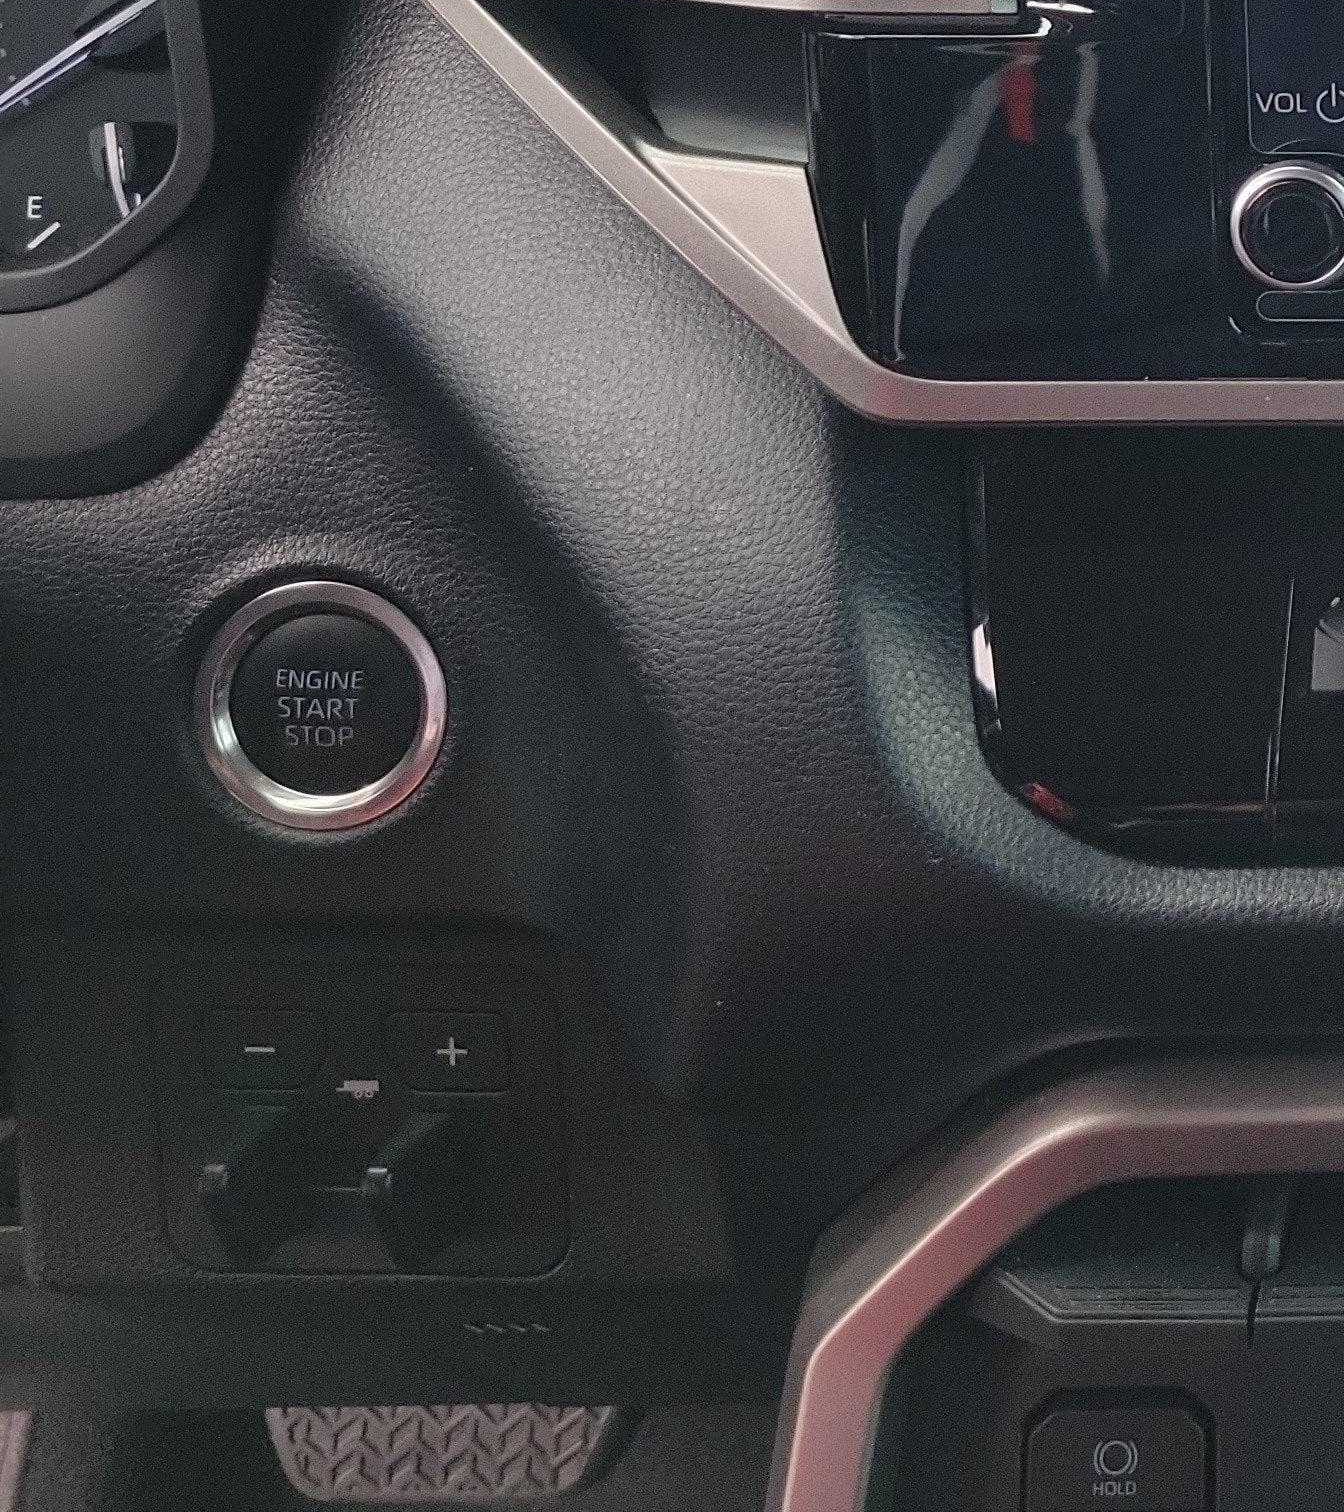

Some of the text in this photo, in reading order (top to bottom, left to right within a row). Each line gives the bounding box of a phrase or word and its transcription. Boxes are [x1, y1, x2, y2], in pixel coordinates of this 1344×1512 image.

[1255, 92, 1308, 113] VOL
[27, 195, 43, 219] E
[275, 668, 364, 690] ENGINE
[277, 696, 360, 720] START
[284, 724, 355, 748] STOP
[1092, 1480, 1138, 1497] HOLD
